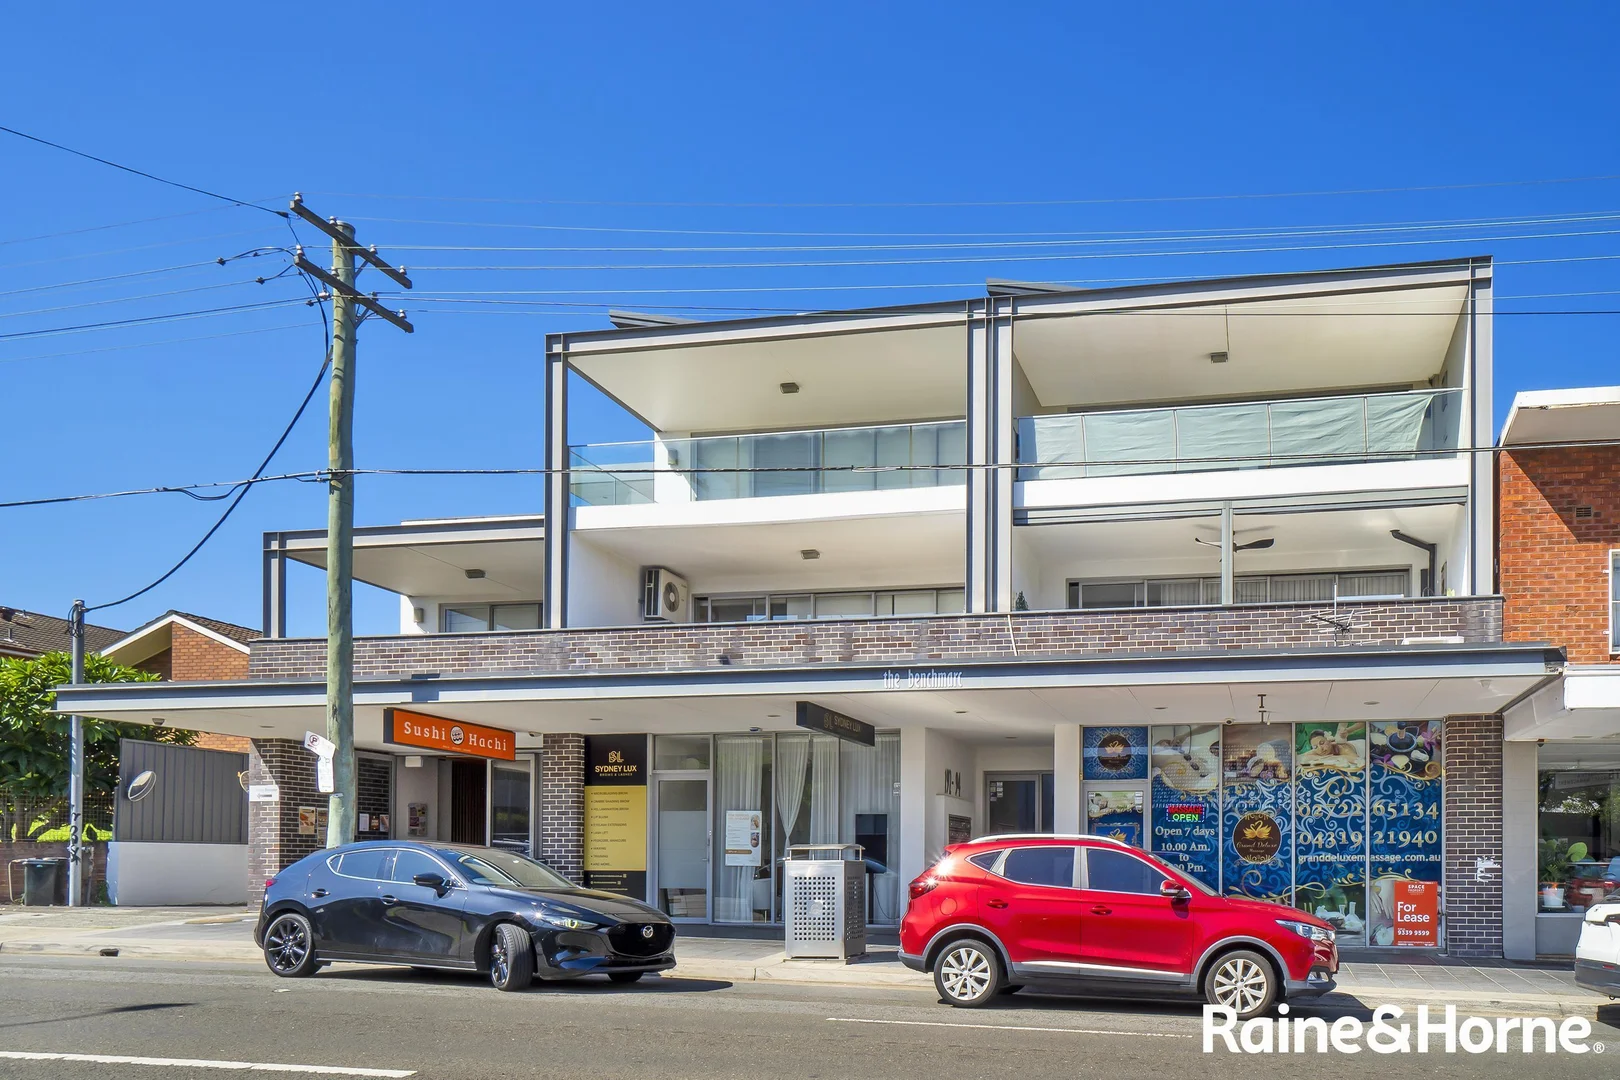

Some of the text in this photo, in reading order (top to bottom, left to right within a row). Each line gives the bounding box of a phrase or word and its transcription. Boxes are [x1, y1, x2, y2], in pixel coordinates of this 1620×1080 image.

[882, 669, 901, 689] the
[404, 721, 507, 751] Sushi Hachi
[594, 765, 622, 773] SYDNEY
[1299, 801, 1439, 820] 02722 65134
[1172, 813, 1199, 821] OPEN
[1155, 826, 1216, 839] Open 7 days
[1300, 831, 1438, 848] 04319 21940
[1161, 842, 1211, 851] 10.00 Am.
[1179, 853, 1190, 862] to
[1186, 862, 1207, 872] Pm.
[1397, 901, 1417, 912] For
[1397, 911, 1430, 923] Lease
